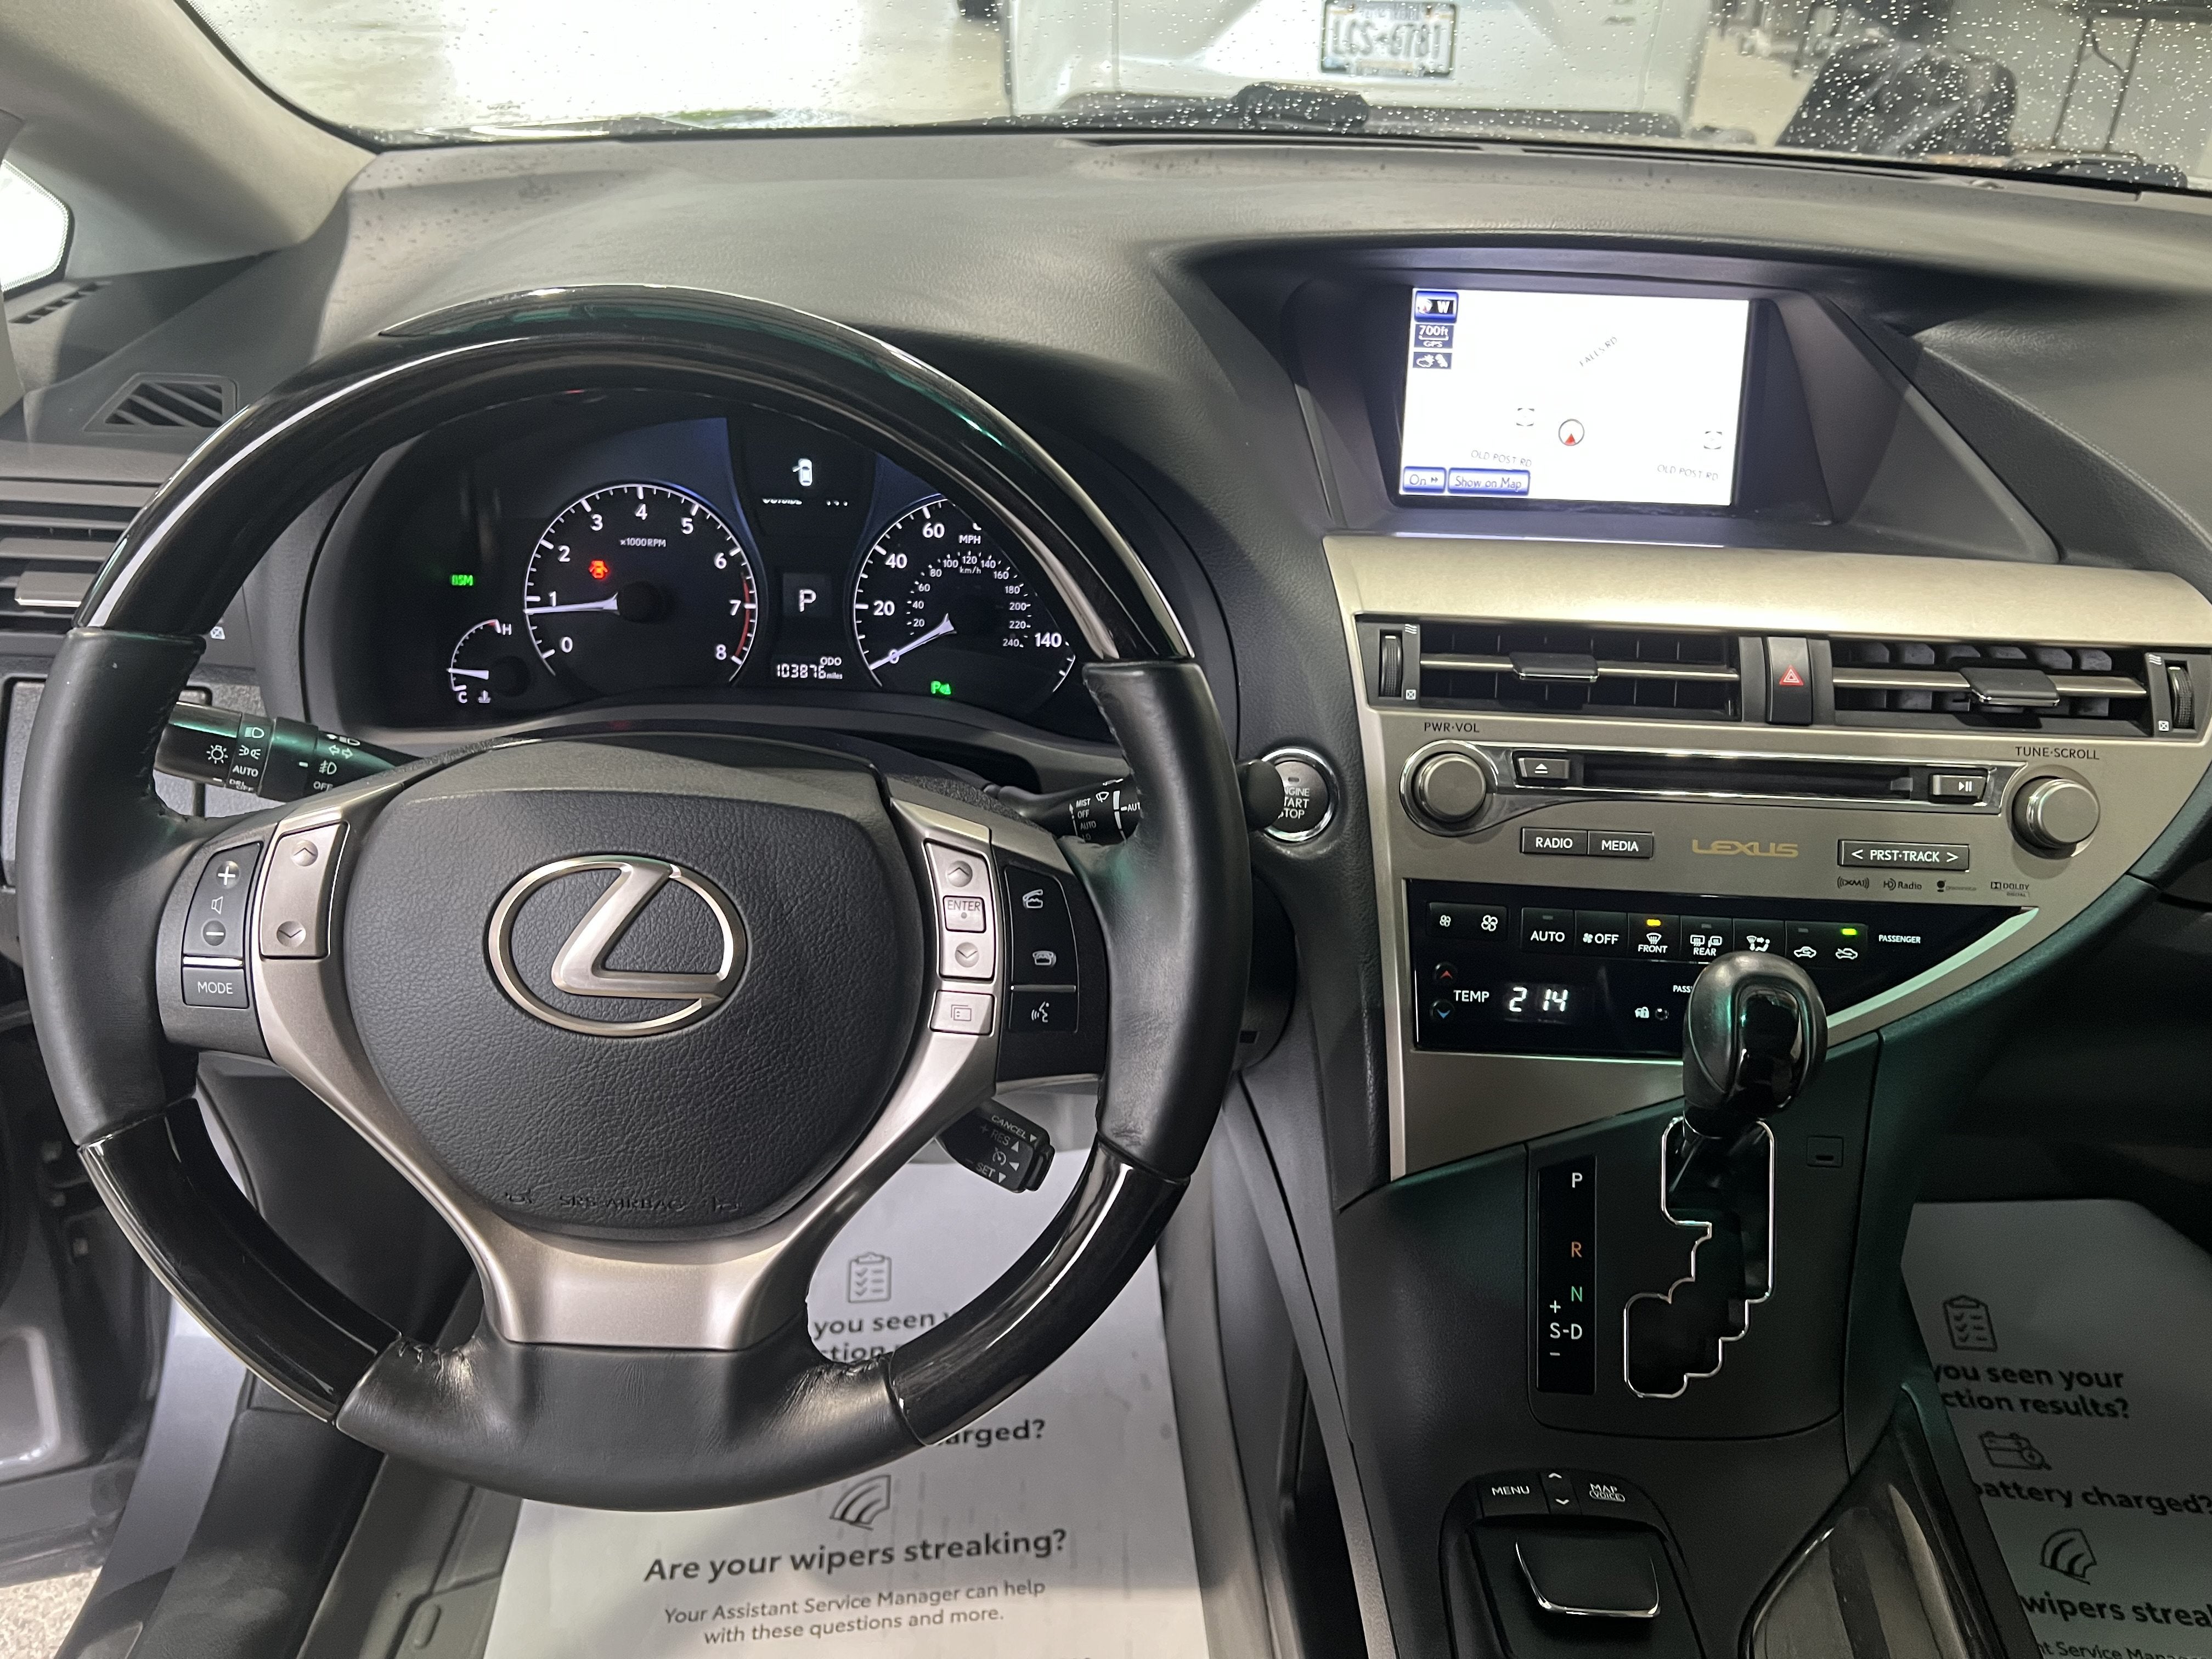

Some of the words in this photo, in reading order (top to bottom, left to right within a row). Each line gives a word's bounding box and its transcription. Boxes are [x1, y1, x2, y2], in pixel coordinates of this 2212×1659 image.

[1437, 300, 1450, 313] W
[1419, 325, 1449, 336] 700ft
[1471, 450, 1489, 460] OLD
[1493, 454, 1517, 464] POST
[1521, 458, 1532, 467] RD
[1657, 464, 1677, 475] OLD
[1679, 467, 1703, 479] POST
[1706, 472, 1719, 481] RD
[1409, 473, 1426, 487] On
[1455, 476, 1481, 488] Show
[1485, 481, 1498, 490] on
[1500, 478, 1521, 493] Map
[635, 504, 647, 520] 4
[591, 515, 603, 531] 3
[681, 518, 693, 534] 5
[922, 523, 945, 539] 60
[959, 534, 981, 545] MPH
[558, 546, 570, 562] 2
[962, 554, 978, 566] 120
[714, 554, 727, 569] 6
[885, 554, 907, 569] 40
[943, 557, 958, 569] 100
[981, 557, 996, 569] 140
[929, 567, 943, 578] 80
[960, 565, 982, 575] km/h
[993, 569, 1009, 580] 160
[918, 582, 931, 592] 60
[1005, 584, 1020, 595] 180
[799, 589, 817, 612] P
[912, 599, 924, 610] 40
[1009, 601, 1027, 612] 200
[730, 600, 741, 616] 7
[873, 601, 895, 617] 20
[913, 618, 925, 628] 20
[1009, 619, 1026, 630] 220
[501, 624, 512, 636] H
[561, 637, 573, 653] 0
[1002, 637, 1020, 648] 240
[1035, 633, 1063, 648] 140
[715, 645, 727, 660] 8
[820, 656, 842, 665] ODO
[777, 663, 826, 679] 103876
[456, 691, 467, 703] C
[233, 765, 258, 777] AUTO
[313, 781, 334, 792] OFF
[1284, 786, 1310, 797] NGINE
[1076, 798, 1091, 808] MIST
[1127, 802, 1141, 812] AUT
[1284, 797, 1310, 809] TART
[1077, 809, 1090, 819] OFF
[1080, 820, 1097, 830] AUTO
[1536, 837, 1573, 849] RADIO
[1601, 839, 1639, 852] MEDIA
[1692, 839, 1799, 857] LEXUS
[1898, 881, 1922, 890] Radio
[947, 901, 981, 912] ENTER
[1531, 931, 1565, 942] AUTO
[1595, 934, 1619, 945] OFF
[1878, 934, 1921, 944] PASSENGER
[1638, 945, 1667, 953] FRONT
[1693, 947, 1717, 956] REAR
[198, 981, 233, 994] MODE
[1453, 990, 1489, 1002] TEMP
[991, 1115, 1026, 1139] CANCEL
[1572, 1172, 1583, 1188] P
[1571, 1242, 1582, 1258] R
[1571, 1286, 1583, 1302] N
[814, 1319, 863, 1340] you
[872, 1313, 934, 1331] seen
[821, 1342, 884, 1361] tion
[1987, 1367, 2053, 1385] seen
[2058, 1370, 2124, 1391] your
[1940, 1388, 2015, 1412] ction
[2020, 1394, 2129, 1419] results?
[938, 1419, 1045, 1448] arged?
[1492, 1486, 1530, 1496] MENU
[1590, 1483, 1617, 1493] MAP
[2082, 1486, 2212, 1516] charged?
[644, 1558, 700, 1582] Are
[708, 1554, 782, 1584] your
[790, 1544, 895, 1575] wipers
[904, 1528, 1067, 1562] streaking?
[664, 1607, 708, 1623] Your
[712, 1601, 799, 1621] Assistant
[804, 1594, 871, 1613] Service
[878, 1588, 960, 1607] Manager
[966, 1584, 998, 1600] can
[1003, 1579, 1046, 1598] help
[2019, 1591, 2125, 1622] wipers
[704, 1626, 745, 1644] with
[752, 1623, 804, 1640] these
[809, 1615, 902, 1639] questions
[909, 1609, 944, 1628] and
[950, 1608, 1005, 1624] more.
[2056, 1641, 2122, 1658] Service
